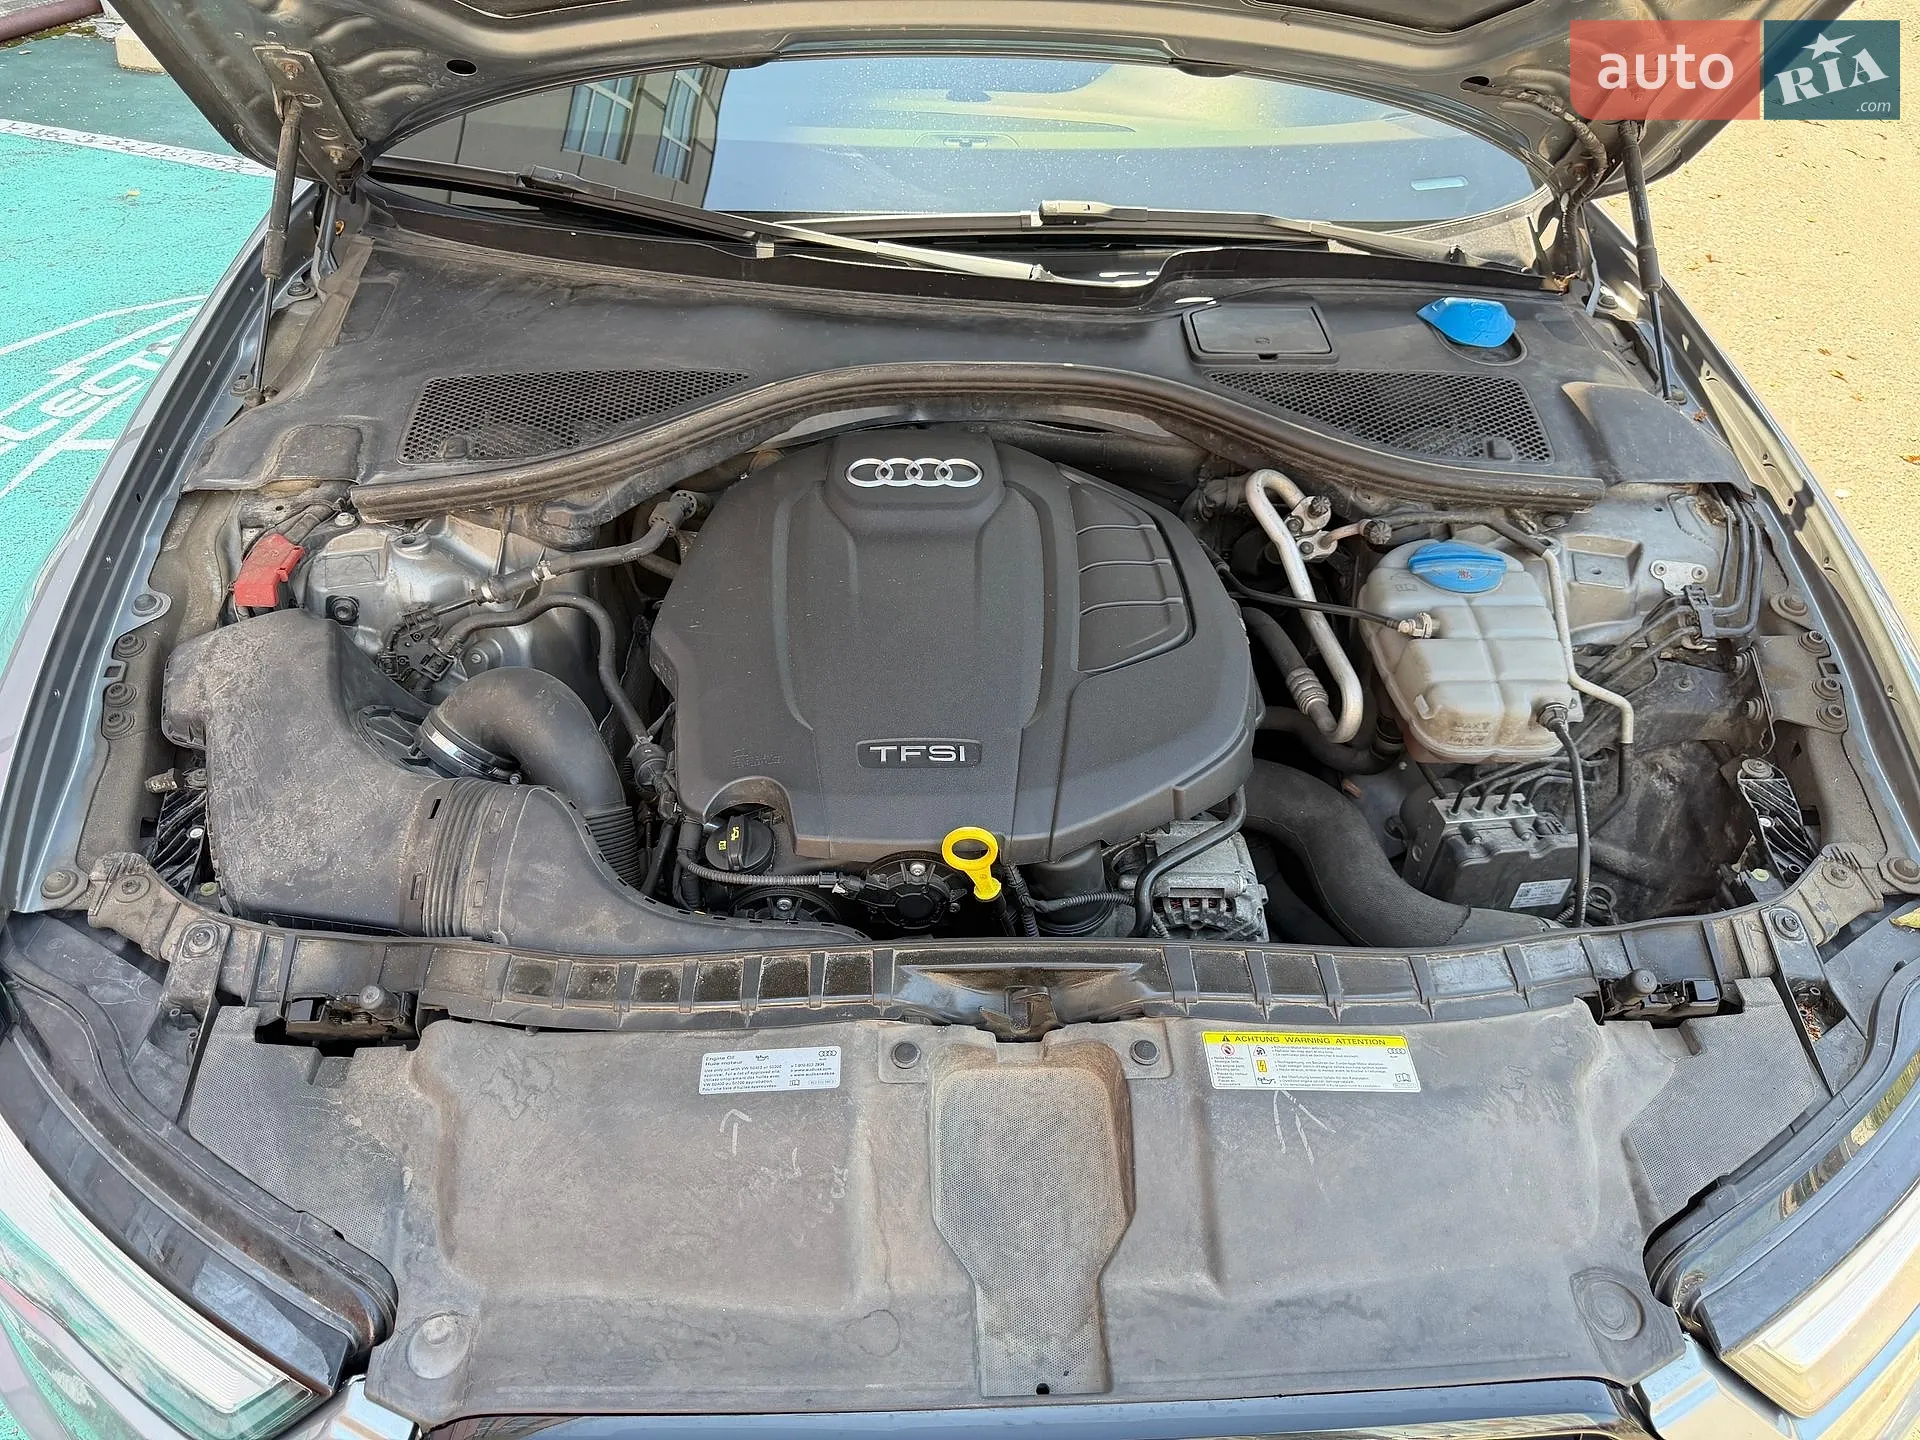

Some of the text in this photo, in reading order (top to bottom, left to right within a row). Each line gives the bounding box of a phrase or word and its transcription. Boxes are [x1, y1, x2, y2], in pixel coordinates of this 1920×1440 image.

[869, 745, 966, 763] TFSI
[1234, 1035, 1387, 1046] ACHTUNG WARNING ATTENTION
